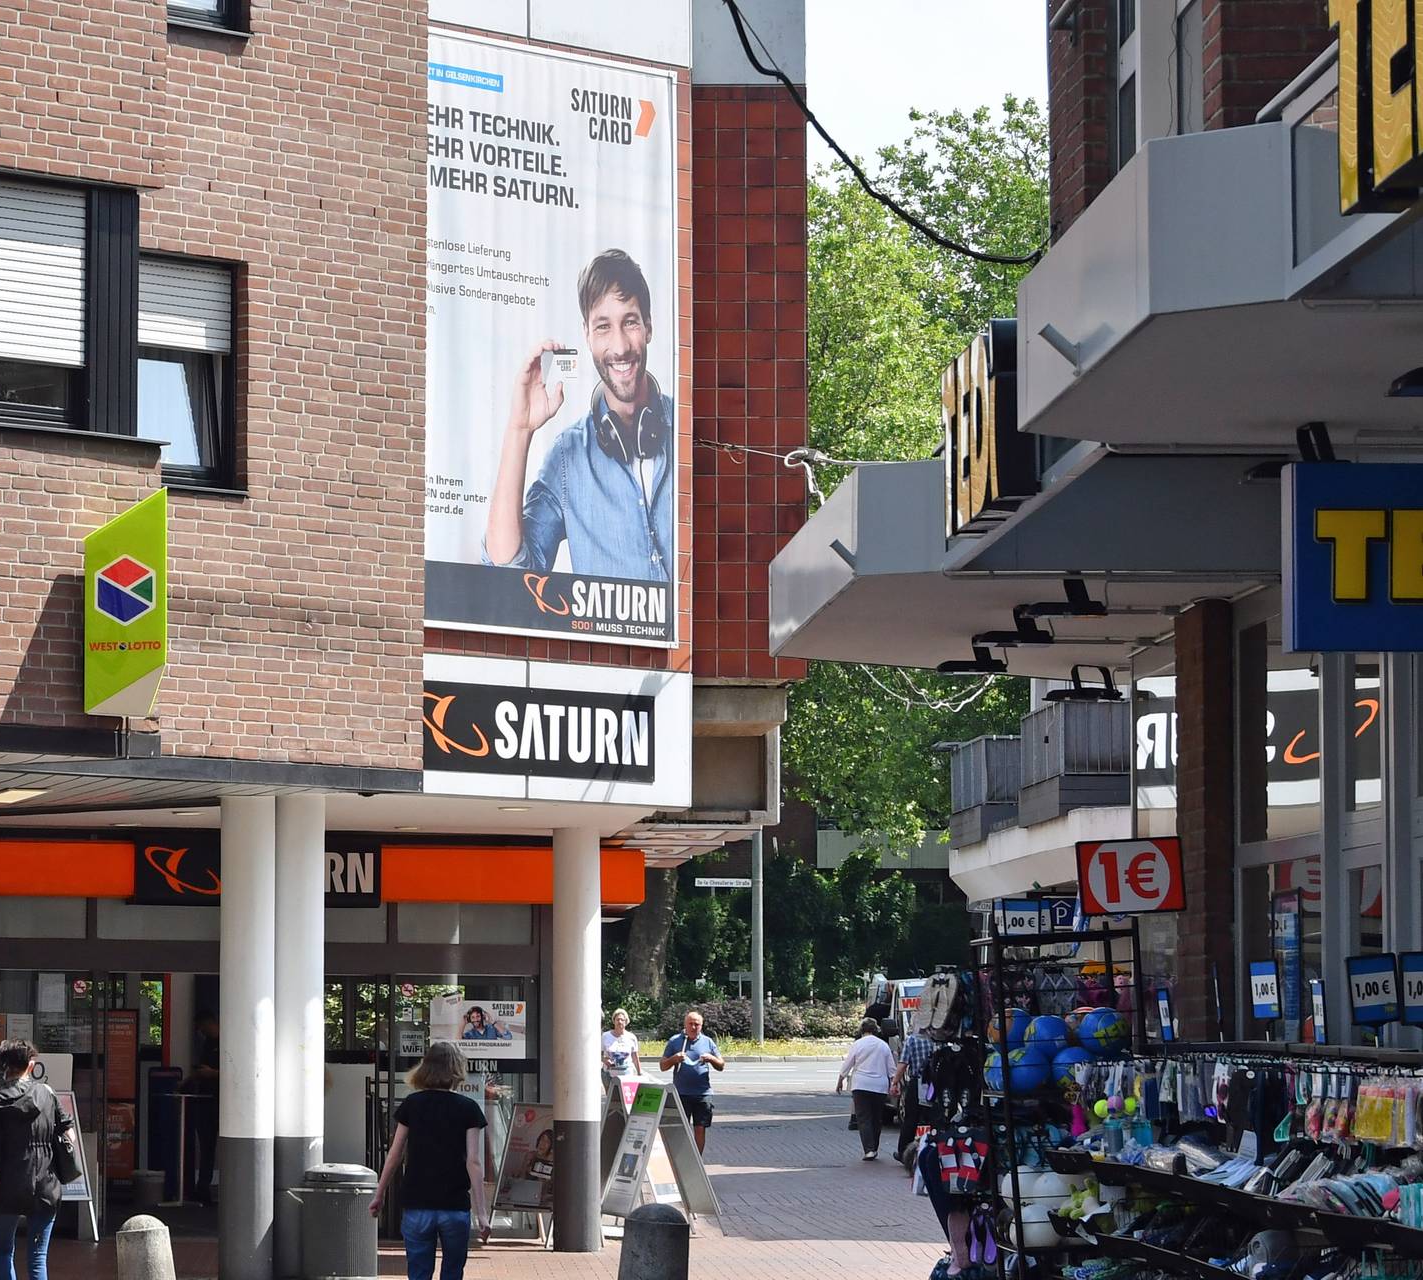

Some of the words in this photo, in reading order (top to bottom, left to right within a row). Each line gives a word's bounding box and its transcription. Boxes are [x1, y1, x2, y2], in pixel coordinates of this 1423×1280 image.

[445, 70, 500, 87] GELSENKIRCHEN
[571, 88, 632, 121] SATURN
[469, 110, 560, 146] TECHNIK.
[589, 117, 632, 145] CARD
[470, 141, 567, 177] VORTEILE.
[430, 164, 488, 194] MEHR
[493, 175, 579, 209] SATURN.
[468, 242, 511, 261] Lieferung
[477, 266, 550, 287] Umtauschrecht
[459, 284, 536, 307] Sonderangebote
[436, 474, 464, 487] Ihrem
[439, 490, 461, 501] oder
[463, 494, 487, 504] unter
[572, 580, 666, 623] SATURN
[596, 622, 623, 634] MUSS
[625, 625, 665, 637] TECHNIK
[89, 642, 117, 652] WEST
[128, 641, 161, 651] LOTTO
[494, 701, 649, 767] SATURN
[1255, 983, 1269, 996] 1,00
[1270, 982, 1276, 994] €
[1355, 982, 1378, 998] 1,00
[1381, 980, 1391, 995] €
[492, 1003, 515, 1011] SATURN
[402, 1045, 423, 1054] WiFi
